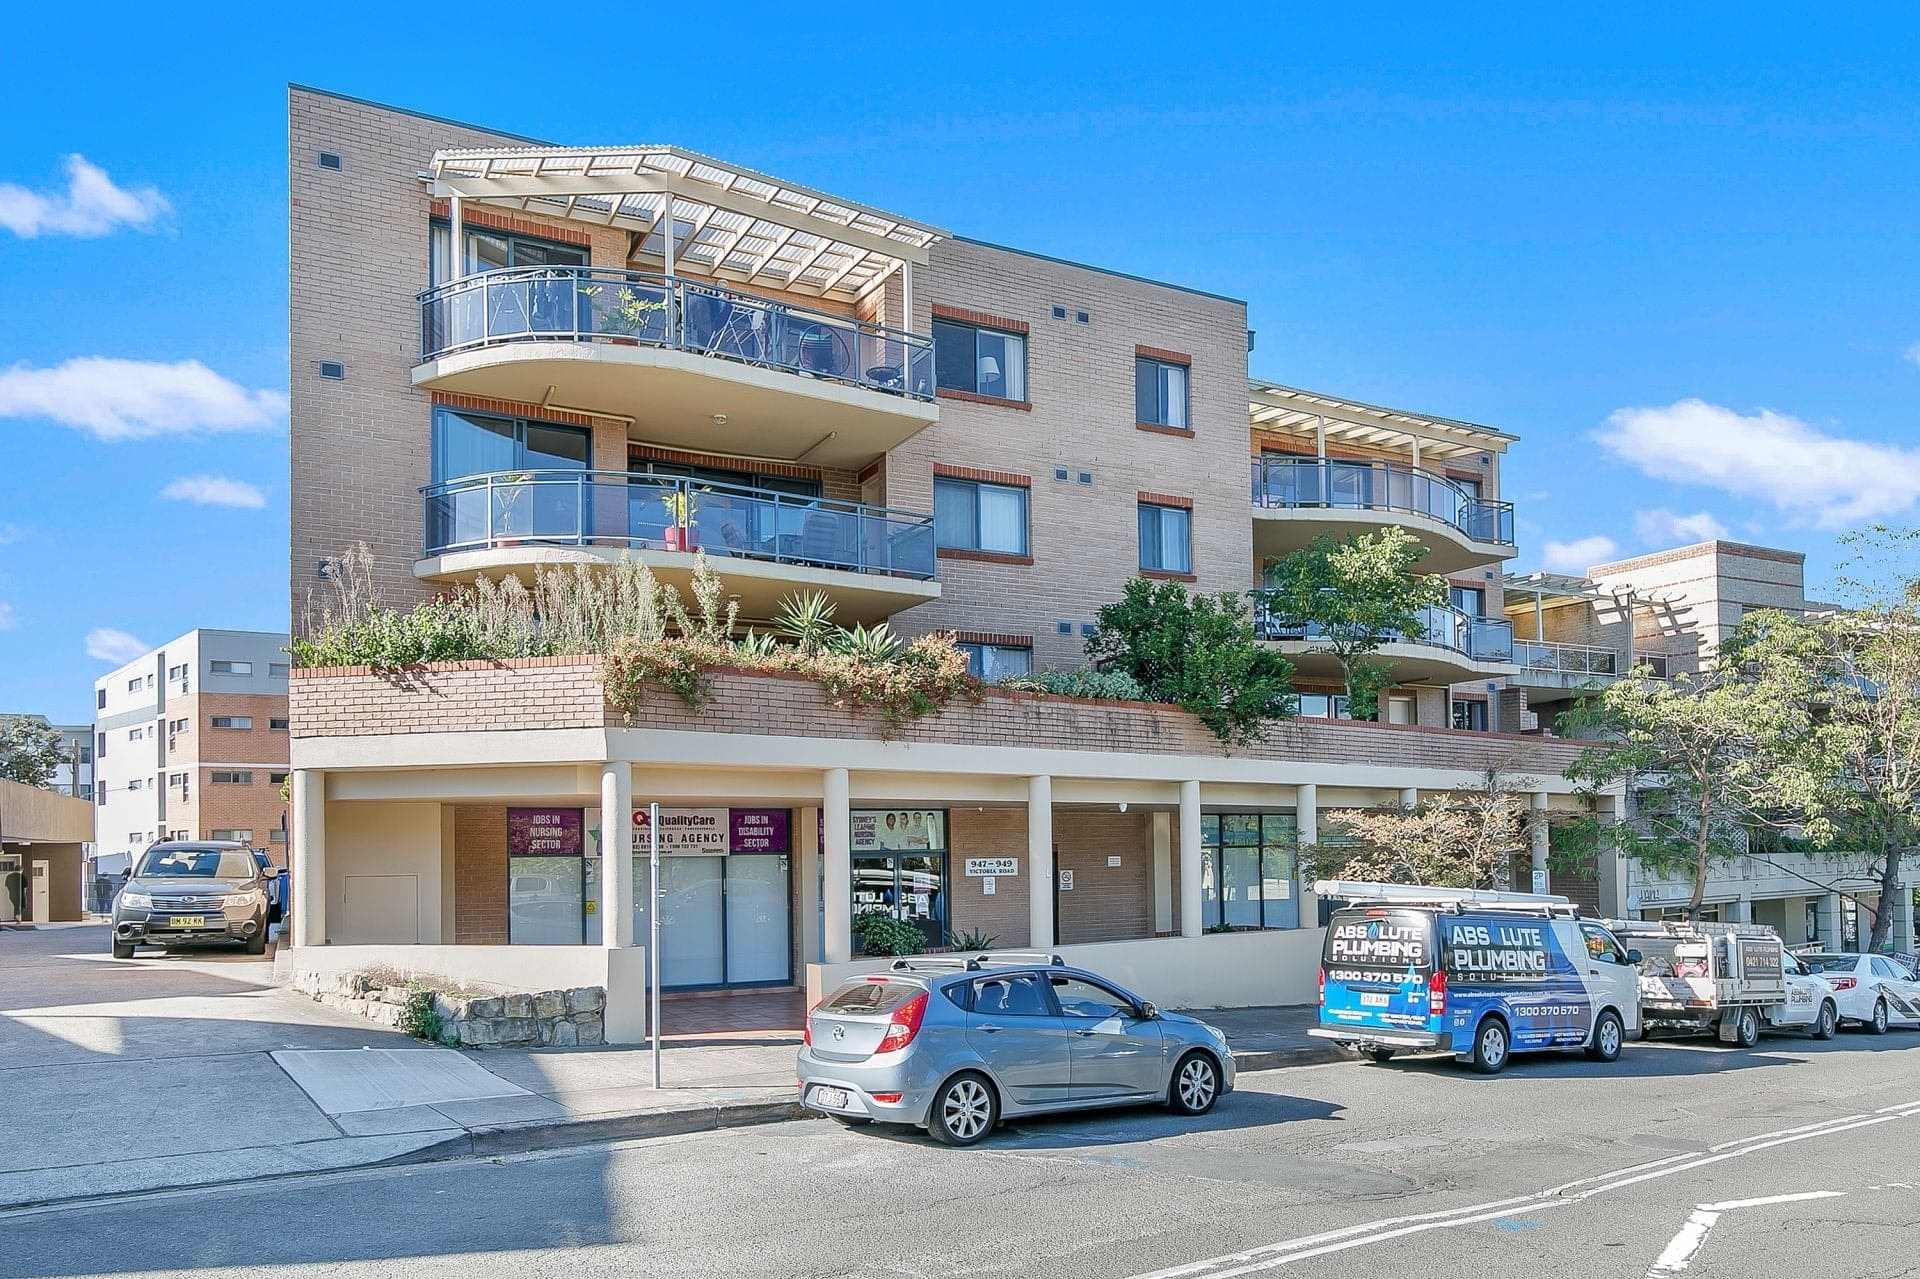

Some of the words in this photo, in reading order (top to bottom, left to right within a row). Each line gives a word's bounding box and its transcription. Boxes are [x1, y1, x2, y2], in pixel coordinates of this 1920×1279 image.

[532, 815, 550, 824] JOBS
[552, 815, 560, 824] IN
[659, 816, 716, 826] QualityCare
[744, 816, 760, 824] JOBS
[761, 816, 768, 824] IN
[530, 828, 562, 837] NURSING
[738, 827, 774, 836] DISABILITY
[681, 834, 724, 842] AGENCY
[532, 840, 560, 849] SECTOR
[744, 838, 769, 848] SECTOR
[1534, 872, 1544, 880] 2P
[1332, 940, 1422, 957] PLUMBING
[1332, 956, 1422, 964] SOLUTIONS
[1454, 950, 1546, 970] PLUMBING
[1760, 957, 1768, 967] 714
[1330, 970, 1362, 980] 1300
[1363, 972, 1391, 982] 370
[1393, 972, 1424, 984] 570
[1458, 973, 1549, 981] SOLUTIONS
[1515, 1008, 1539, 1016] 1300
[1540, 1006, 1560, 1016] 370
[1560, 1006, 1579, 1015] 570
